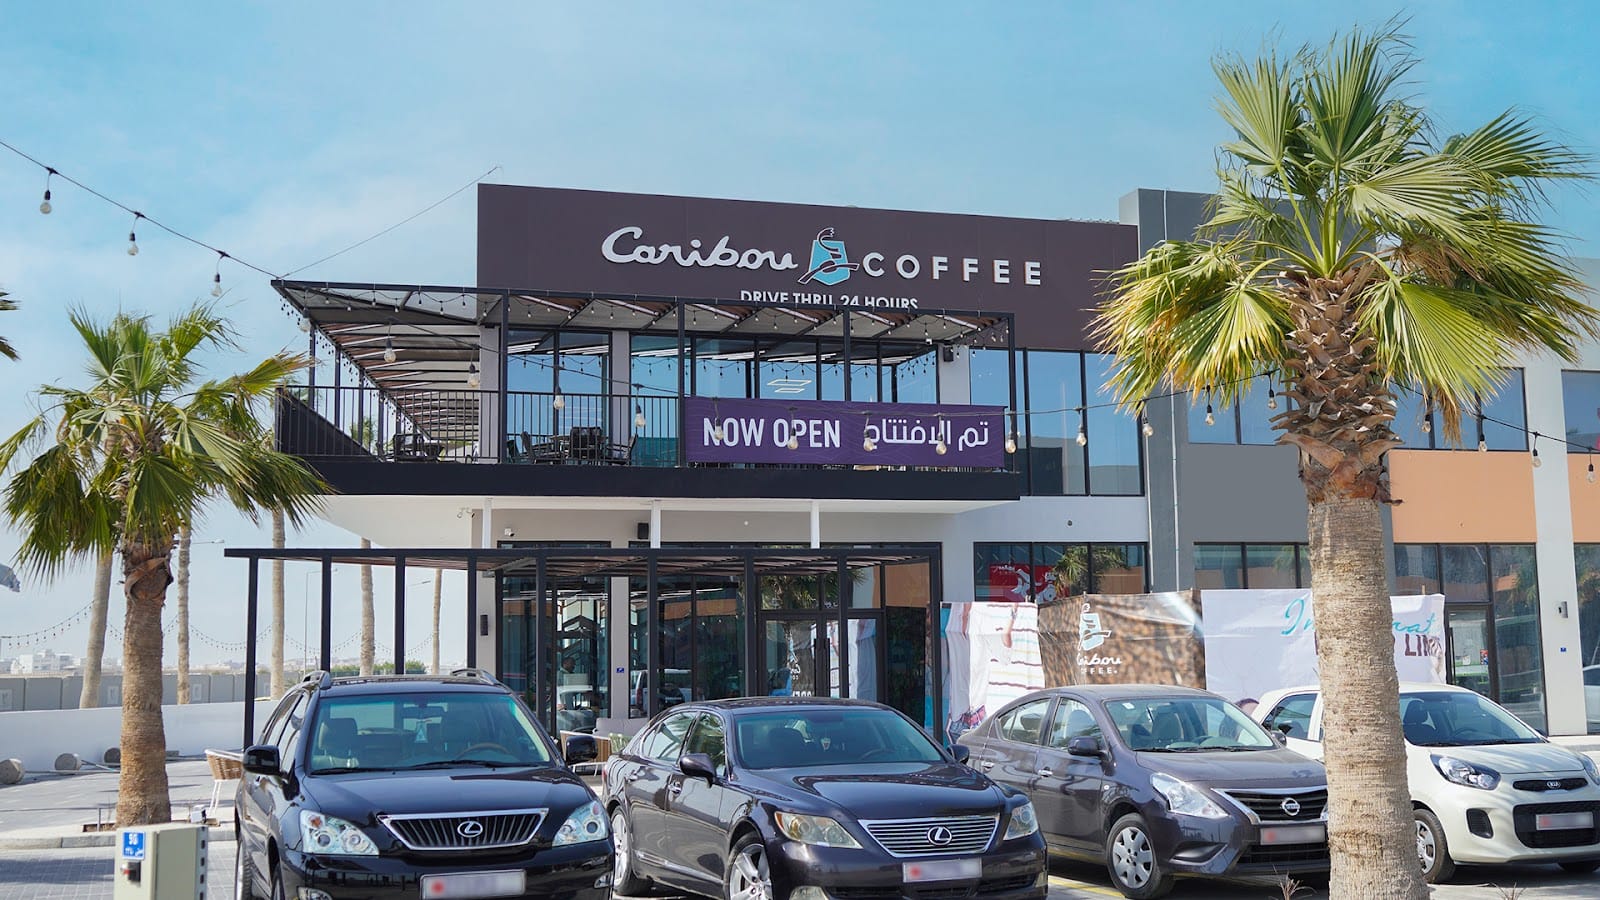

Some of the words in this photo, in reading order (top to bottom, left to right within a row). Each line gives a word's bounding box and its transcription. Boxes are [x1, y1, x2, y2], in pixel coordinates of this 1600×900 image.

[601, 226, 798, 271] Caribou
[862, 252, 1042, 285] COFFEE
[740, 290, 789, 302] DRIVE
[793, 293, 833, 305] THRU
[840, 295, 860, 306] 24
[865, 297, 918, 309] HOURS
[703, 417, 764, 446] NOW
[773, 418, 841, 448] OPEN
[958, 421, 989, 451] تم
